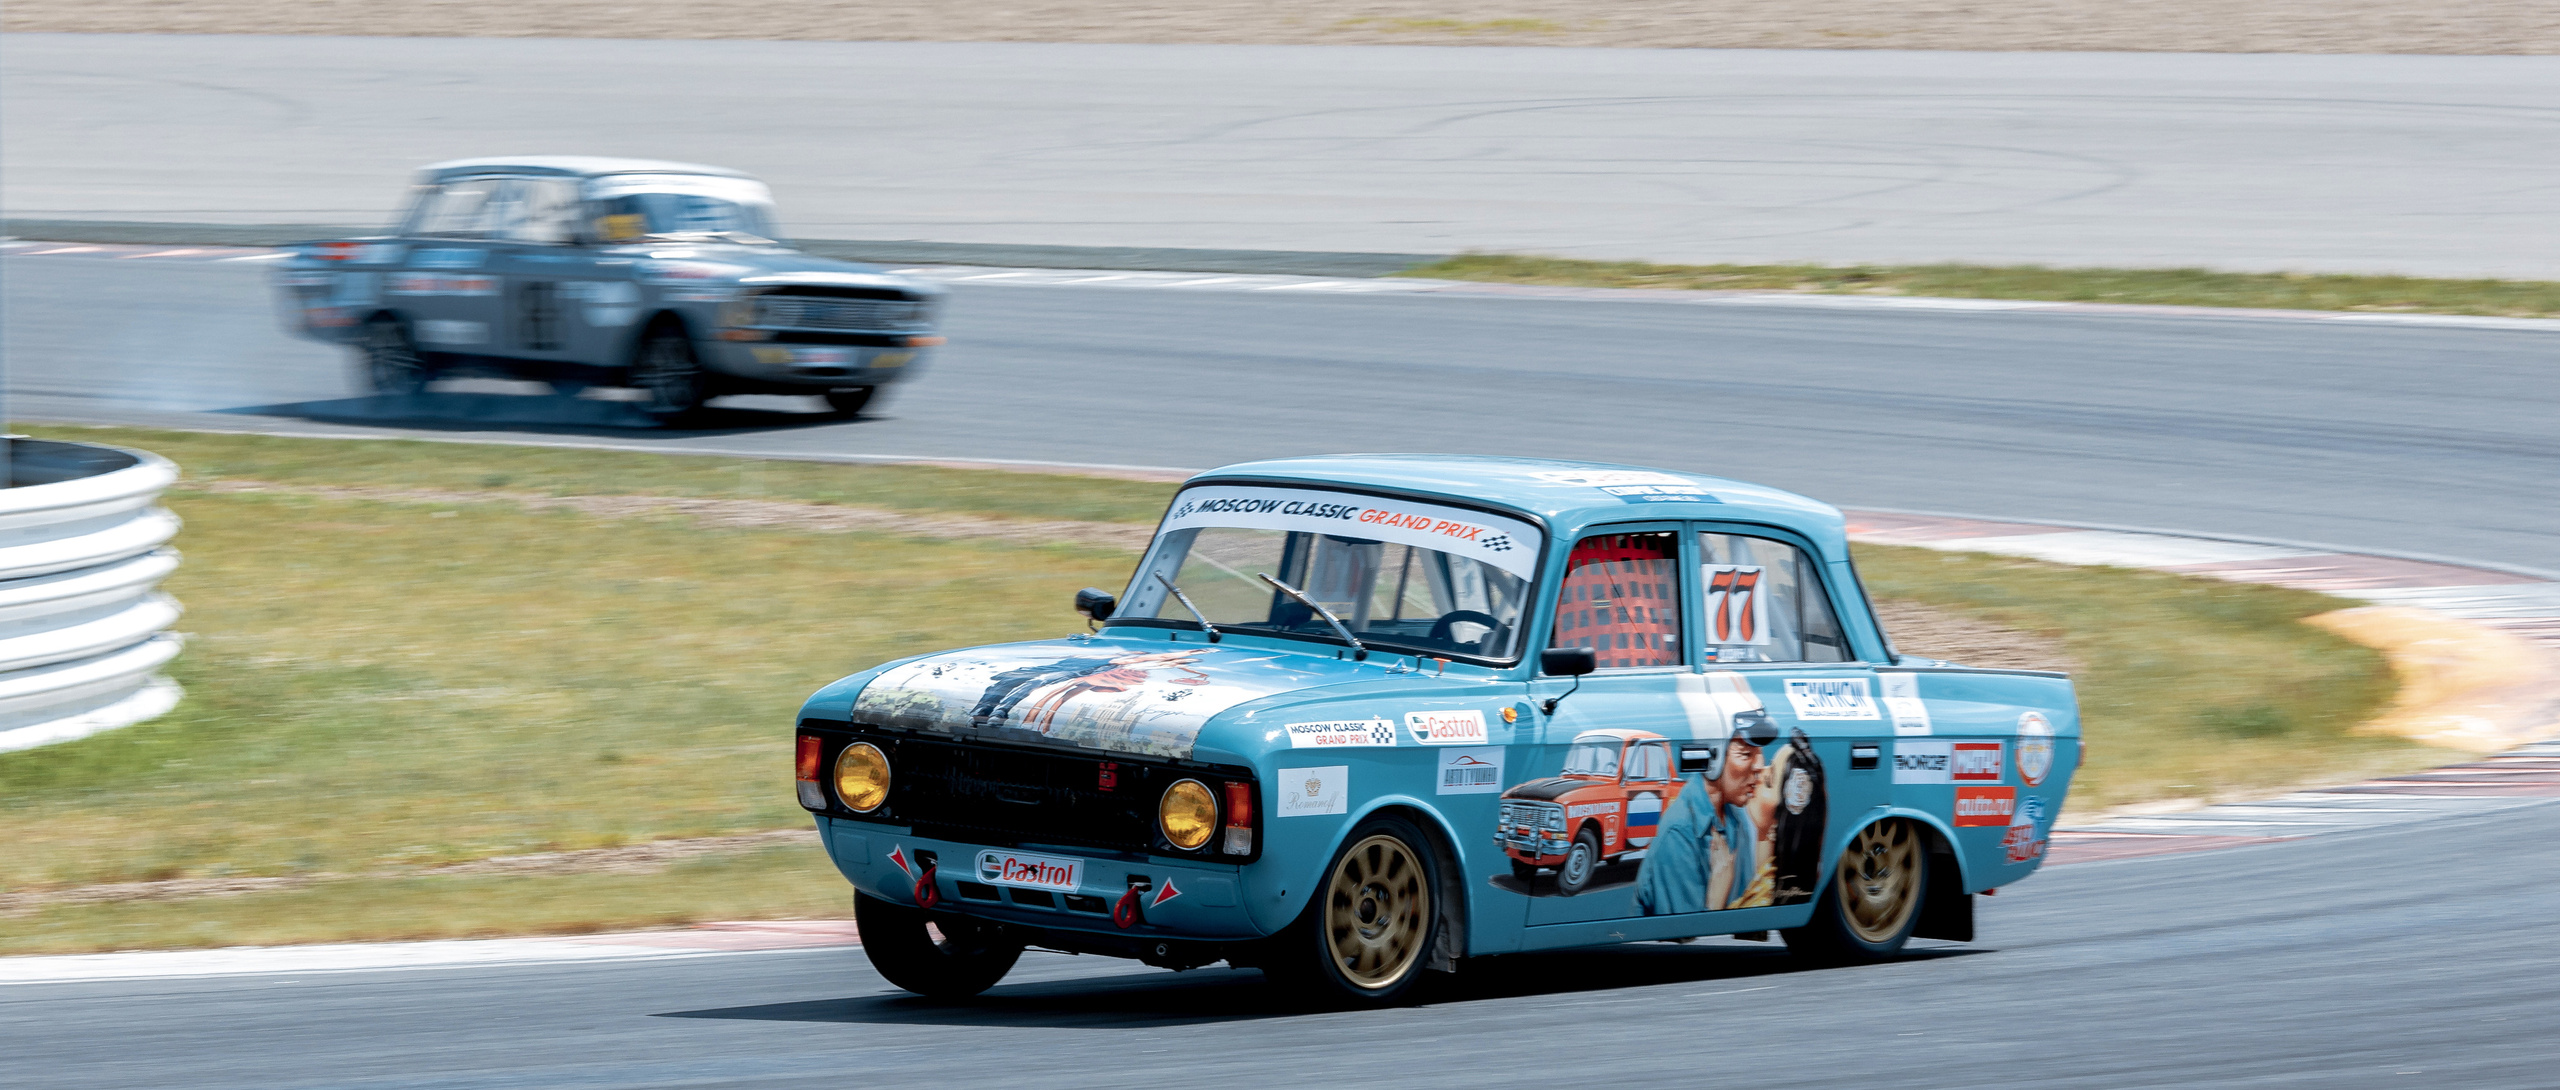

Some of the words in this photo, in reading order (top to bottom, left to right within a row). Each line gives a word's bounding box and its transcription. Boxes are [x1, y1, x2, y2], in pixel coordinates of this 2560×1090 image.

[1196, 498, 1285, 514] MOSCOW
[1283, 501, 1360, 520] CLASSIC
[1359, 509, 1432, 531] GRAND
[1431, 521, 1484, 541] PRIX
[1709, 568, 1760, 642] 77
[1290, 723, 1331, 735] MOSCOW
[1333, 722, 1367, 733] CLASSIC
[1315, 734, 1347, 745] GRAND
[1349, 734, 1370, 744] PRIX
[1428, 716, 1482, 738] Castrol
[1002, 857, 1073, 887] Castrol
